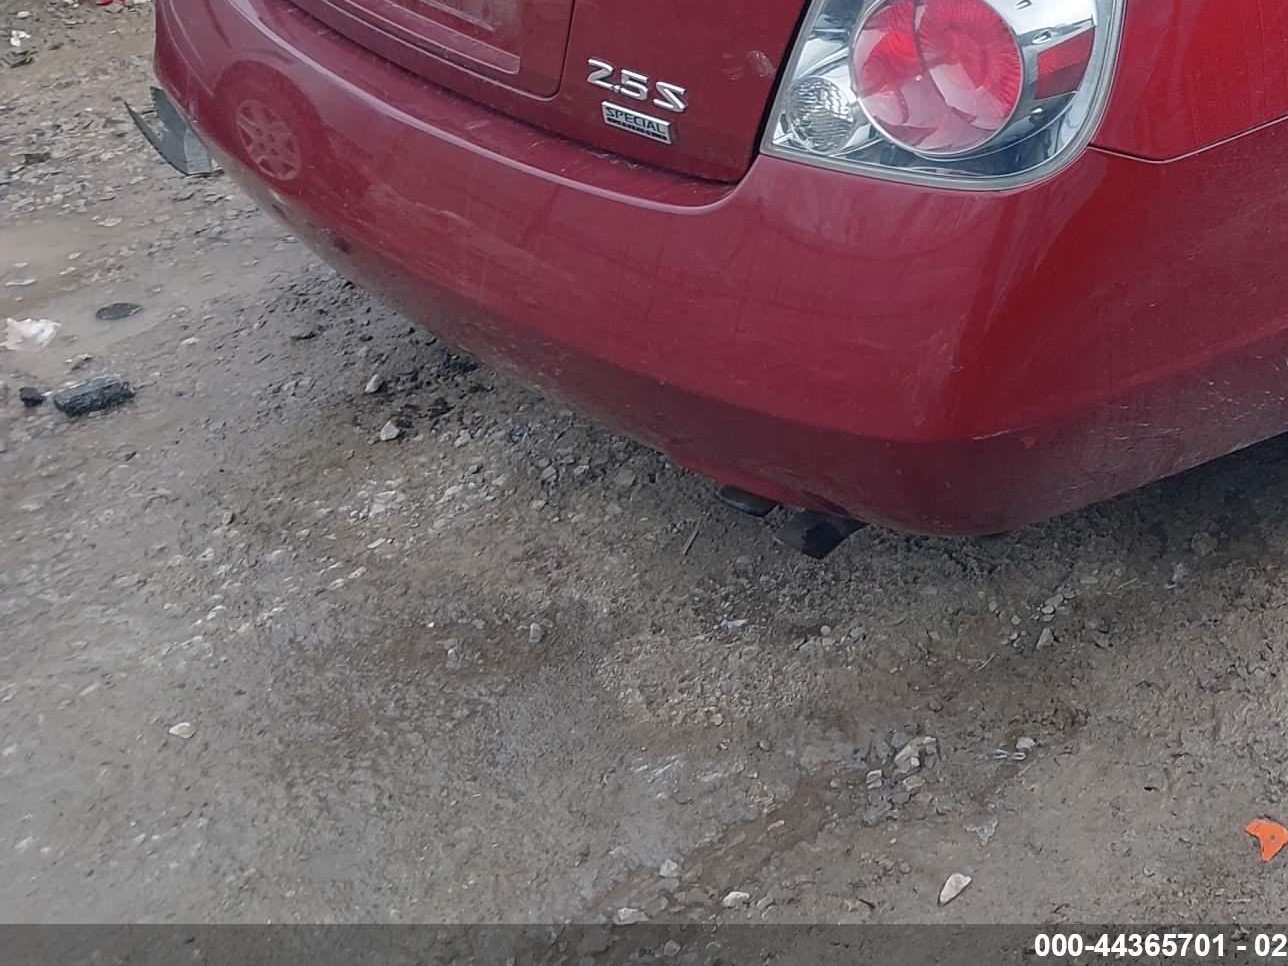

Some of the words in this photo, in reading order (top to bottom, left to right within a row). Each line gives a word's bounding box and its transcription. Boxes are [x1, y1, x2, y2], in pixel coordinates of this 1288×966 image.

[586, 58, 648, 101] 2.5
[653, 81, 688, 113] S
[605, 106, 668, 134] SPECIAL
